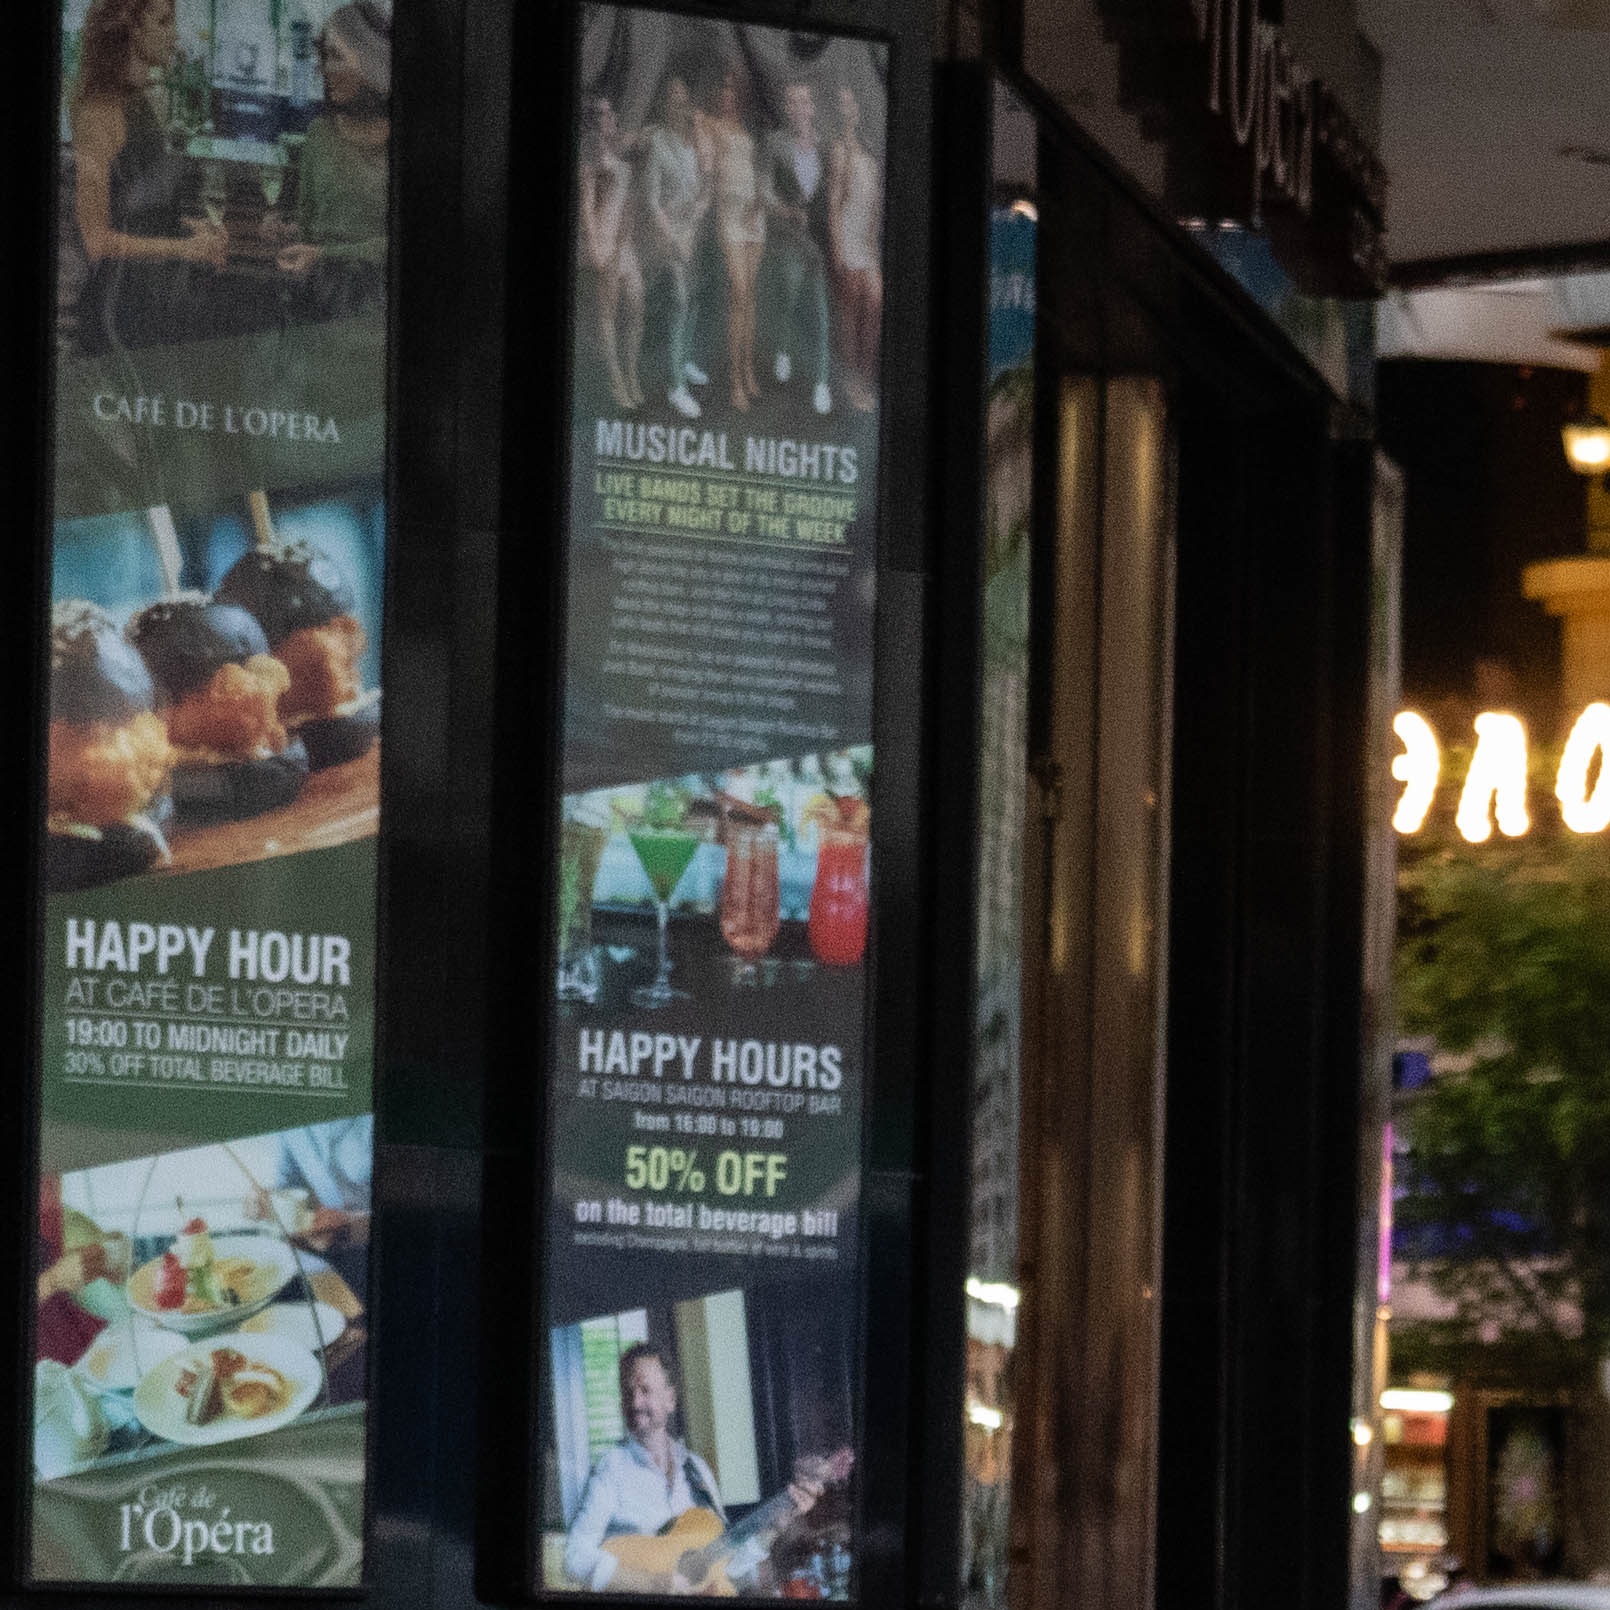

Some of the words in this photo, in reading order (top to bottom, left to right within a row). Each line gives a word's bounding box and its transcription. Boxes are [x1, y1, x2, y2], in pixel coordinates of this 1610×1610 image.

[175, 400, 215, 432] DE
[596, 418, 736, 471] MUSICAL
[745, 436, 860, 485] NIGHTS
[594, 473, 636, 496] LIVE
[640, 477, 702, 506] BANDS
[706, 482, 740, 509] SET
[744, 487, 779, 513] THE
[782, 491, 857, 523] GROOVE
[604, 497, 663, 525] EVERY
[667, 503, 725, 532] NIGHT
[728, 510, 752, 534] OF
[757, 514, 790, 539] THE
[796, 518, 847, 545] WEEK
[65, 917, 215, 977] HAPPY
[228, 928, 351, 986] HOUR
[65, 975, 101, 1006] AT
[106, 977, 180, 1012] CAFÉ
[186, 983, 226, 1014] DE
[231, 986, 350, 1022] L'OPERA
[65, 1018, 128, 1048] 19:00
[132, 1020, 161, 1051] TO
[168, 1023, 281, 1057] MIDNIGHT
[285, 1030, 350, 1061] DAILY
[579, 1027, 702, 1081] HAPPY
[711, 1037, 843, 1092] HOURS
[65, 1051, 106, 1076] 30%
[110, 1053, 146, 1078] OFF
[149, 1055, 208, 1082] TOTAL
[210, 1057, 306, 1088] BEVERAGE
[309, 1064, 349, 1089] BILL
[578, 1079, 599, 1098] AT
[602, 1079, 663, 1104] SAIGON
[666, 1083, 727, 1108] SAIGON
[729, 1087, 806, 1114] ROOFTOP
[807, 1094, 843, 1116] BAR
[633, 1110, 671, 1132] from
[720, 1117, 737, 1137] to
[625, 1143, 707, 1194] 50%
[715, 1149, 789, 1198] OFF
[575, 1200, 603, 1224] on
[606, 1198, 641, 1226] the
[645, 1200, 694, 1229] total
[699, 1203, 798, 1240] beverage
[801, 1209, 840, 1238] bill
[120, 1503, 275, 1567] l'Opéra
